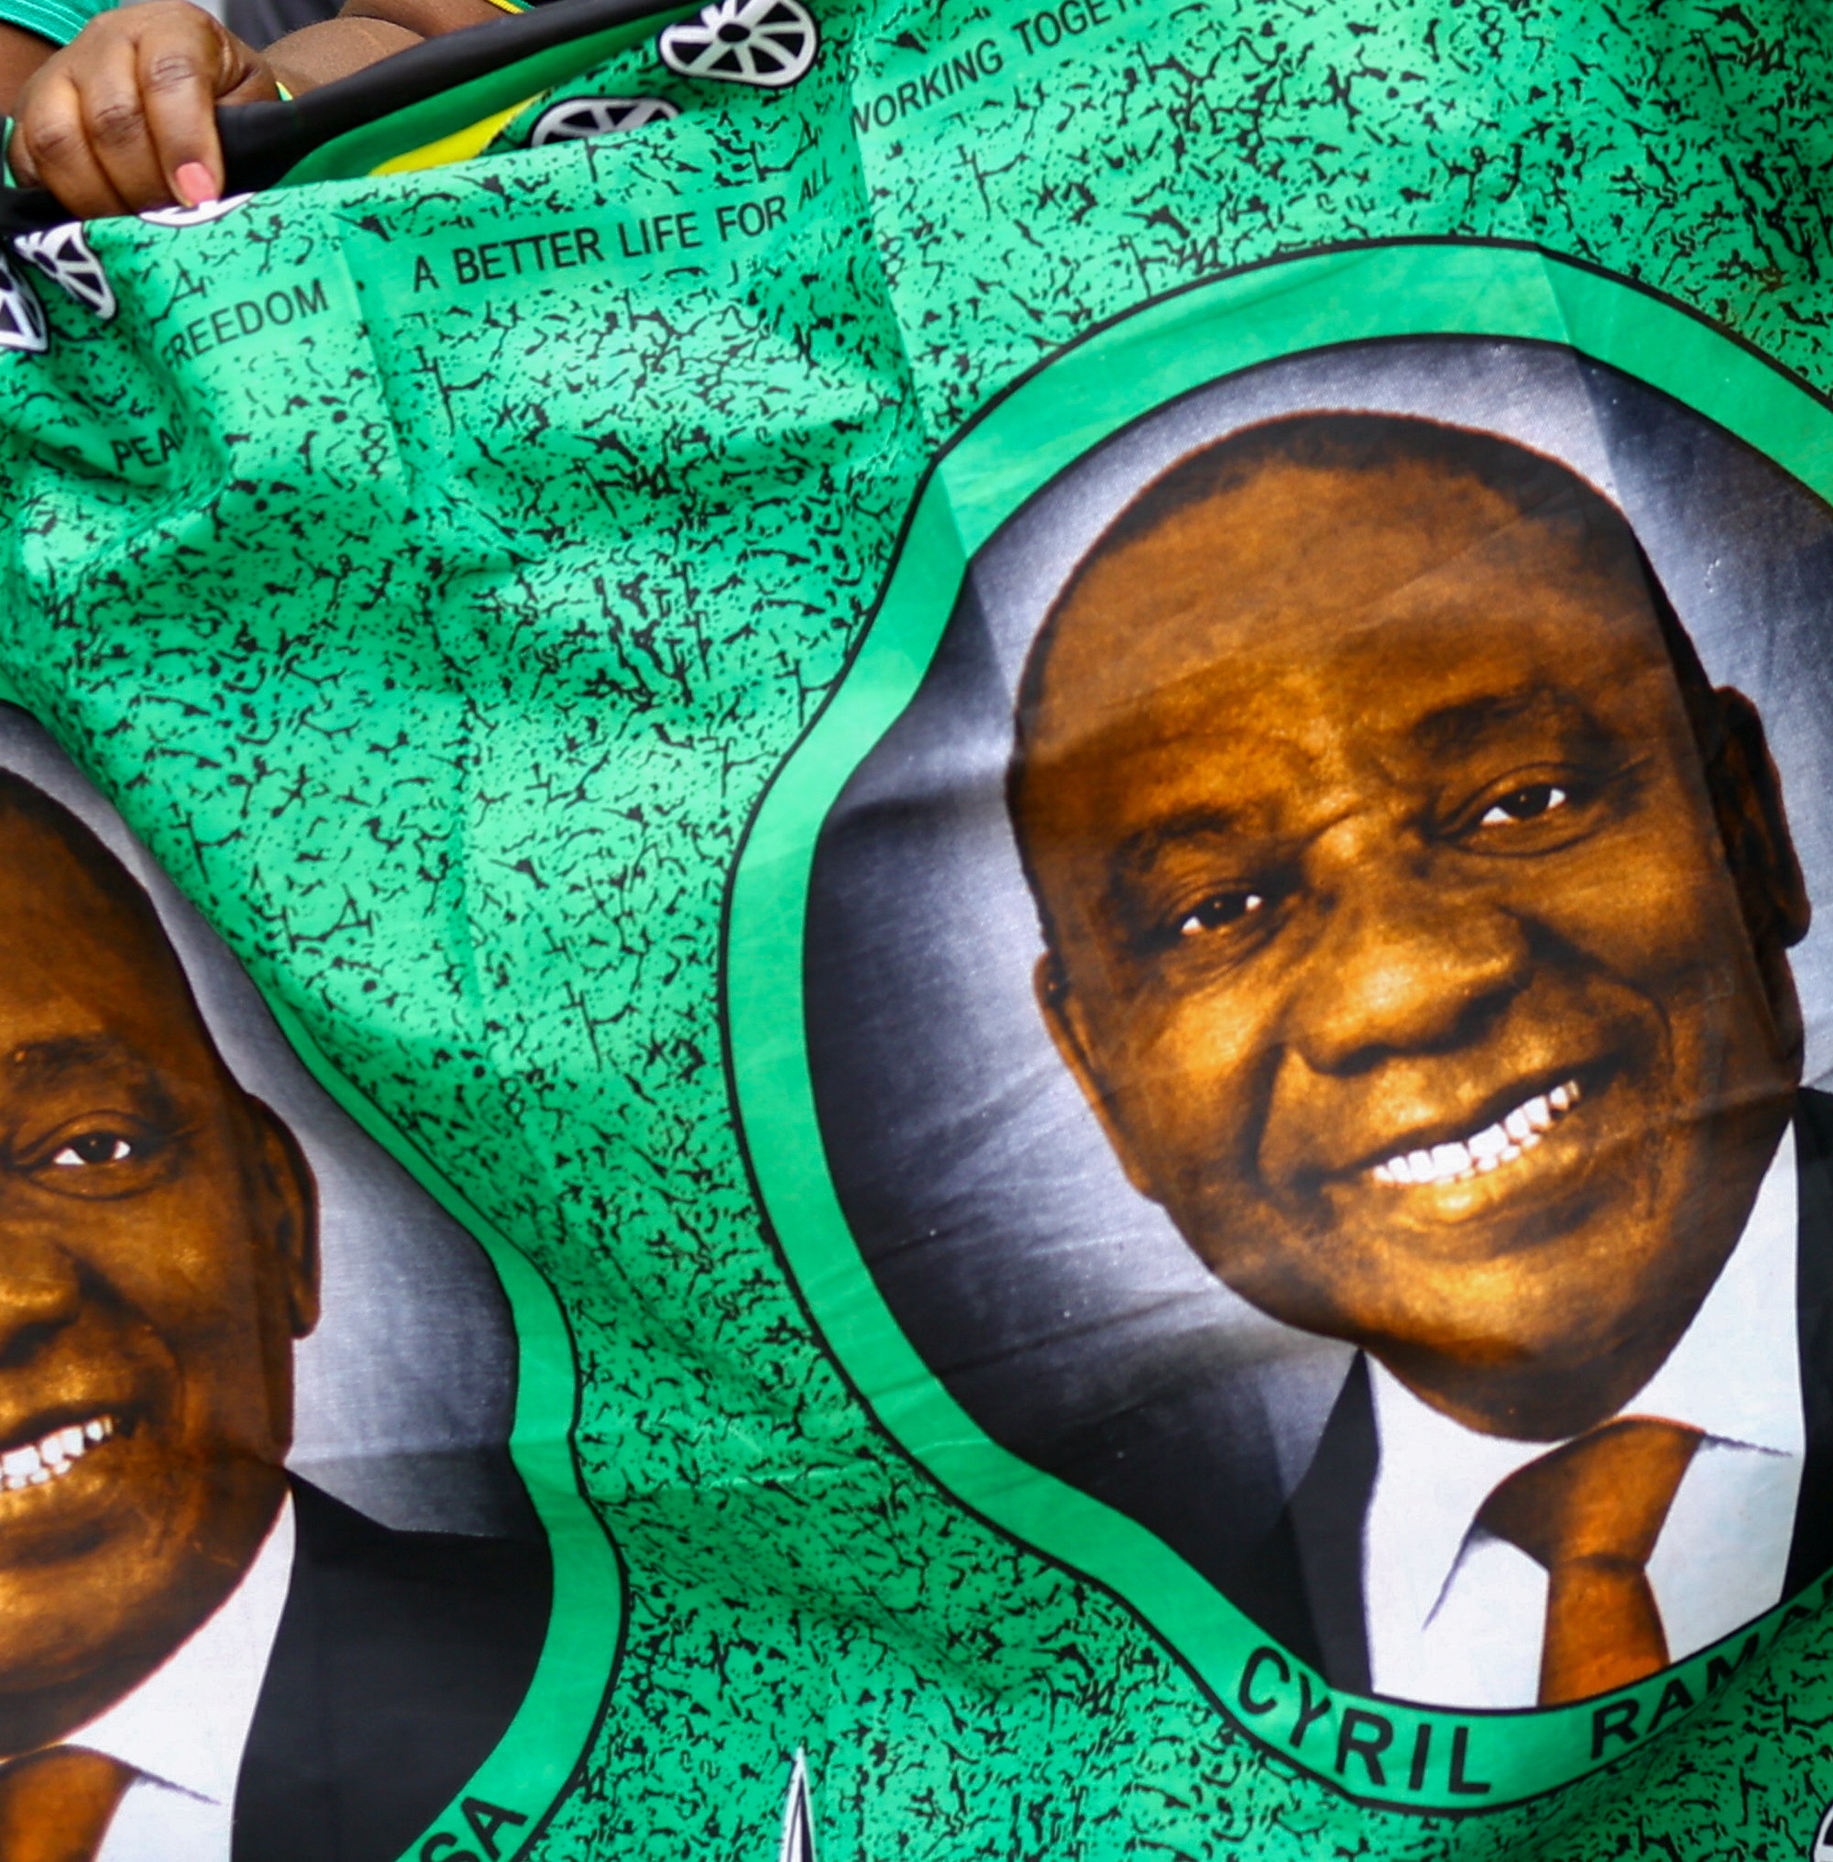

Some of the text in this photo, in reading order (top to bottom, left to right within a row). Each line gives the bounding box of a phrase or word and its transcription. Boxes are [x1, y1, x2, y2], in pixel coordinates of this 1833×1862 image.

[162, 278, 329, 370] REEDOM
[412, 254, 438, 294] A
[455, 227, 603, 285] BETTER
[618, 210, 702, 259] LIFE
[716, 194, 788, 241] FOR
[798, 156, 832, 211] ALL
[1237, 1645, 1493, 1796] CYRIL
